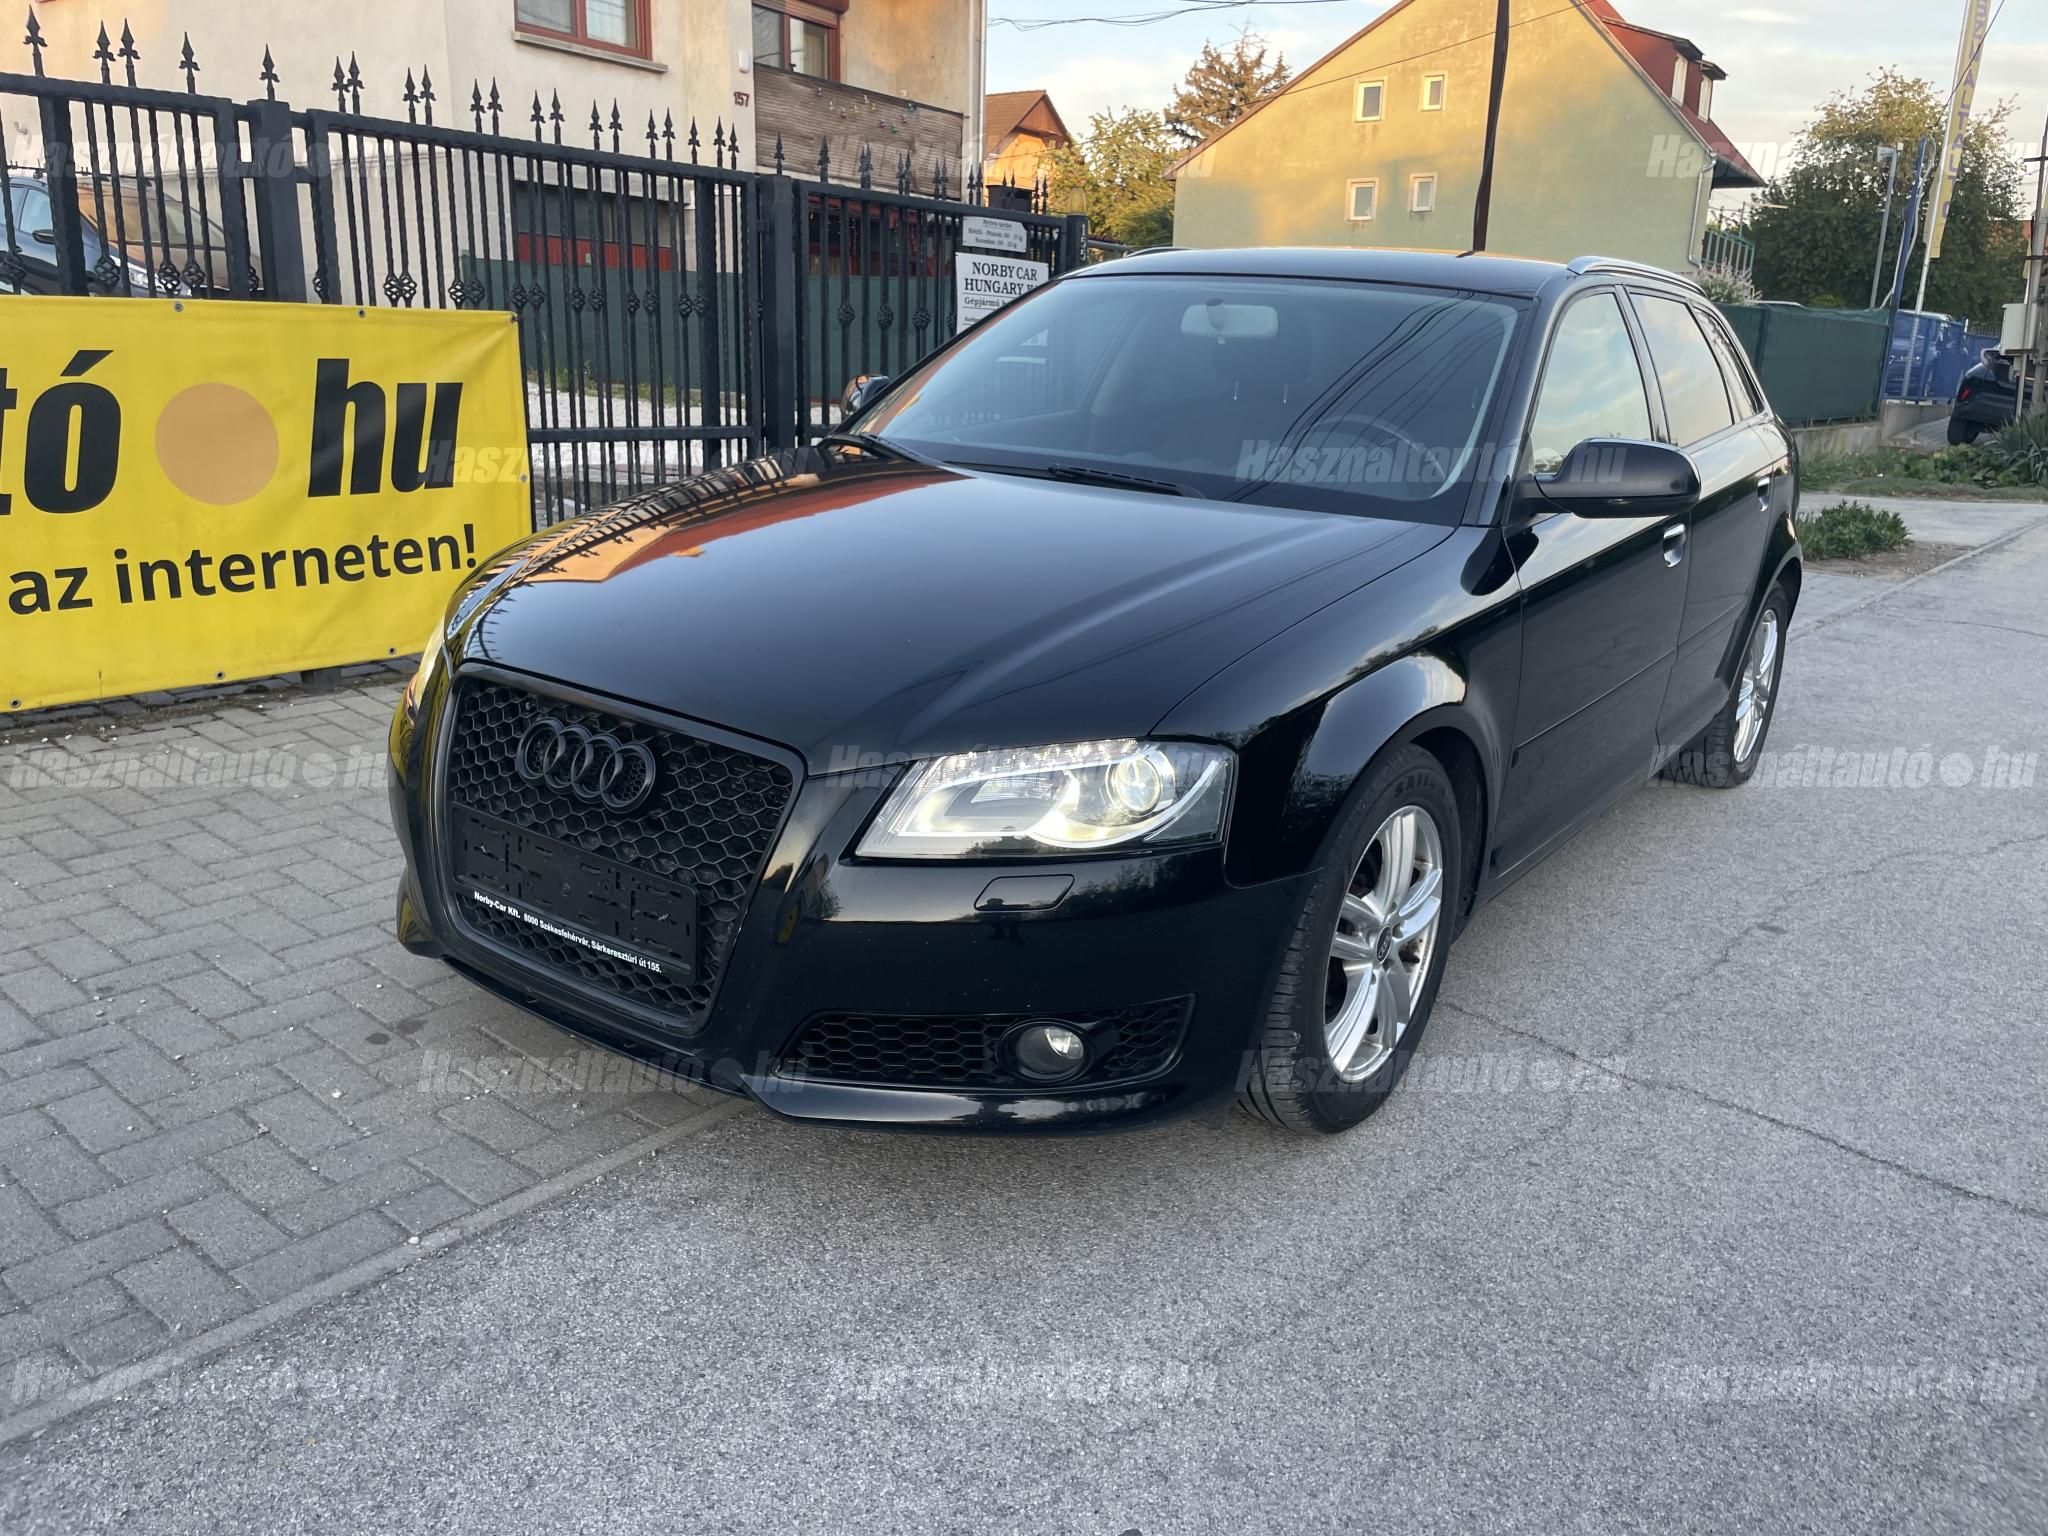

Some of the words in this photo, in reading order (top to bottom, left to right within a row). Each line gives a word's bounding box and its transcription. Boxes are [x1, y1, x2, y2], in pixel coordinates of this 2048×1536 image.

[733, 91, 750, 107] 157
[964, 278, 1024, 295] HUNGARY
[972, 262, 1016, 278] NORBY
[1016, 267, 1038, 281] CAR
[308, 358, 463, 497] hu
[9, 566, 93, 615] az
[114, 523, 478, 604] interneten!
[474, 891, 507, 913] Norby-Car
[507, 907, 521, 918] Kft.
[523, 913, 539, 926] 8000
[539, 919, 591, 949] Székesfehérvár,
[591, 941, 638, 965] Sárkeresztúri
[647, 961, 662, 973] 155.
